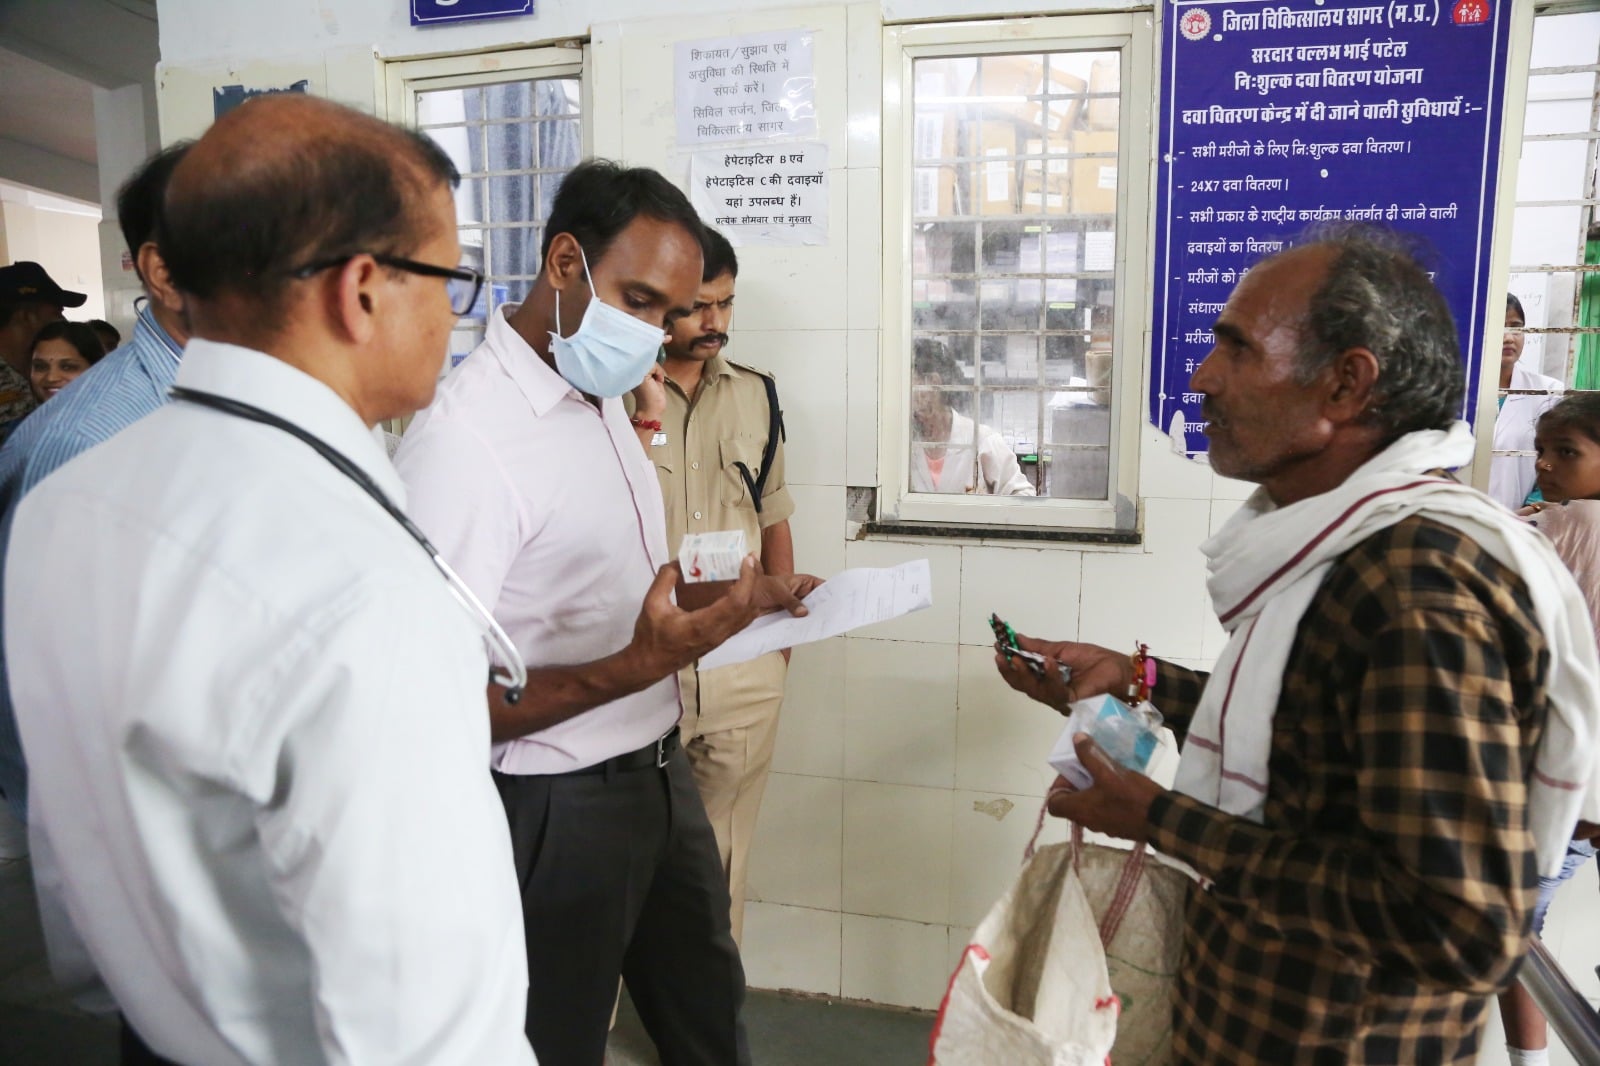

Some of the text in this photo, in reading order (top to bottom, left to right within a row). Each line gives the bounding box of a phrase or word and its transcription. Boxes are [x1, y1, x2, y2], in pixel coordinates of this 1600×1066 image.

[1222, 9, 1260, 33] जिला
[1261, 8, 1344, 30] चिकित्सालय
[1346, 5, 1385, 25] सागर
[773, 42, 788, 54] एवं
[1251, 38, 1408, 64] सरदार वल्लभ भाई पटेल
[689, 68, 726, 82] असुविधा
[731, 65, 744, 76] की
[1295, 72, 1321, 89] दवा
[1323, 67, 1372, 88] वितरण
[1374, 65, 1424, 85] योजना
[714, 83, 738, 96] संपर्क
[693, 105, 723, 119] सिविल
[1182, 109, 1208, 125] दवा
[1209, 105, 1258, 124] वितरण
[1260, 102, 1293, 124] केन्द्र
[1294, 101, 1309, 121] में
[1310, 100, 1327, 120] दी
[1328, 100, 1359, 120] जाने
[1361, 100, 1398, 119] वाली
[759, 121, 784, 131] सागर
[1192, 141, 1216, 158] सभी
[1253, 140, 1265, 156] के
[1267, 139, 1290, 158] लिए
[1342, 142, 1362, 156] दवा
[1366, 137, 1404, 154] वितरण
[724, 151, 804, 166] हेपेटाइटिस B एवं
[706, 176, 754, 189] हेपेटाइटिस
[760, 177, 766, 185] C
[769, 174, 782, 185] की
[1222, 179, 1242, 192] दवा
[1245, 174, 1282, 192] वितरण
[749, 197, 785, 206] उपलब्ध
[742, 215, 768, 224] सोमवार
[773, 214, 784, 223] एवं
[789, 216, 812, 227] गुरुवार
[1190, 205, 1214, 223] सभी
[1216, 208, 1244, 222] प्रकार
[1248, 206, 1258, 222] के
[1261, 204, 1296, 225] राष्ट्रीय
[1386, 203, 1398, 221] दी
[1401, 203, 1427, 220] जाने
[1429, 202, 1458, 220] वाली
[1187, 237, 1227, 255] दवाइयों
[1229, 242, 1244, 253] का
[1187, 268, 1219, 284] मरीजों
[1221, 268, 1236, 284] को
[1185, 359, 1194, 374] में
